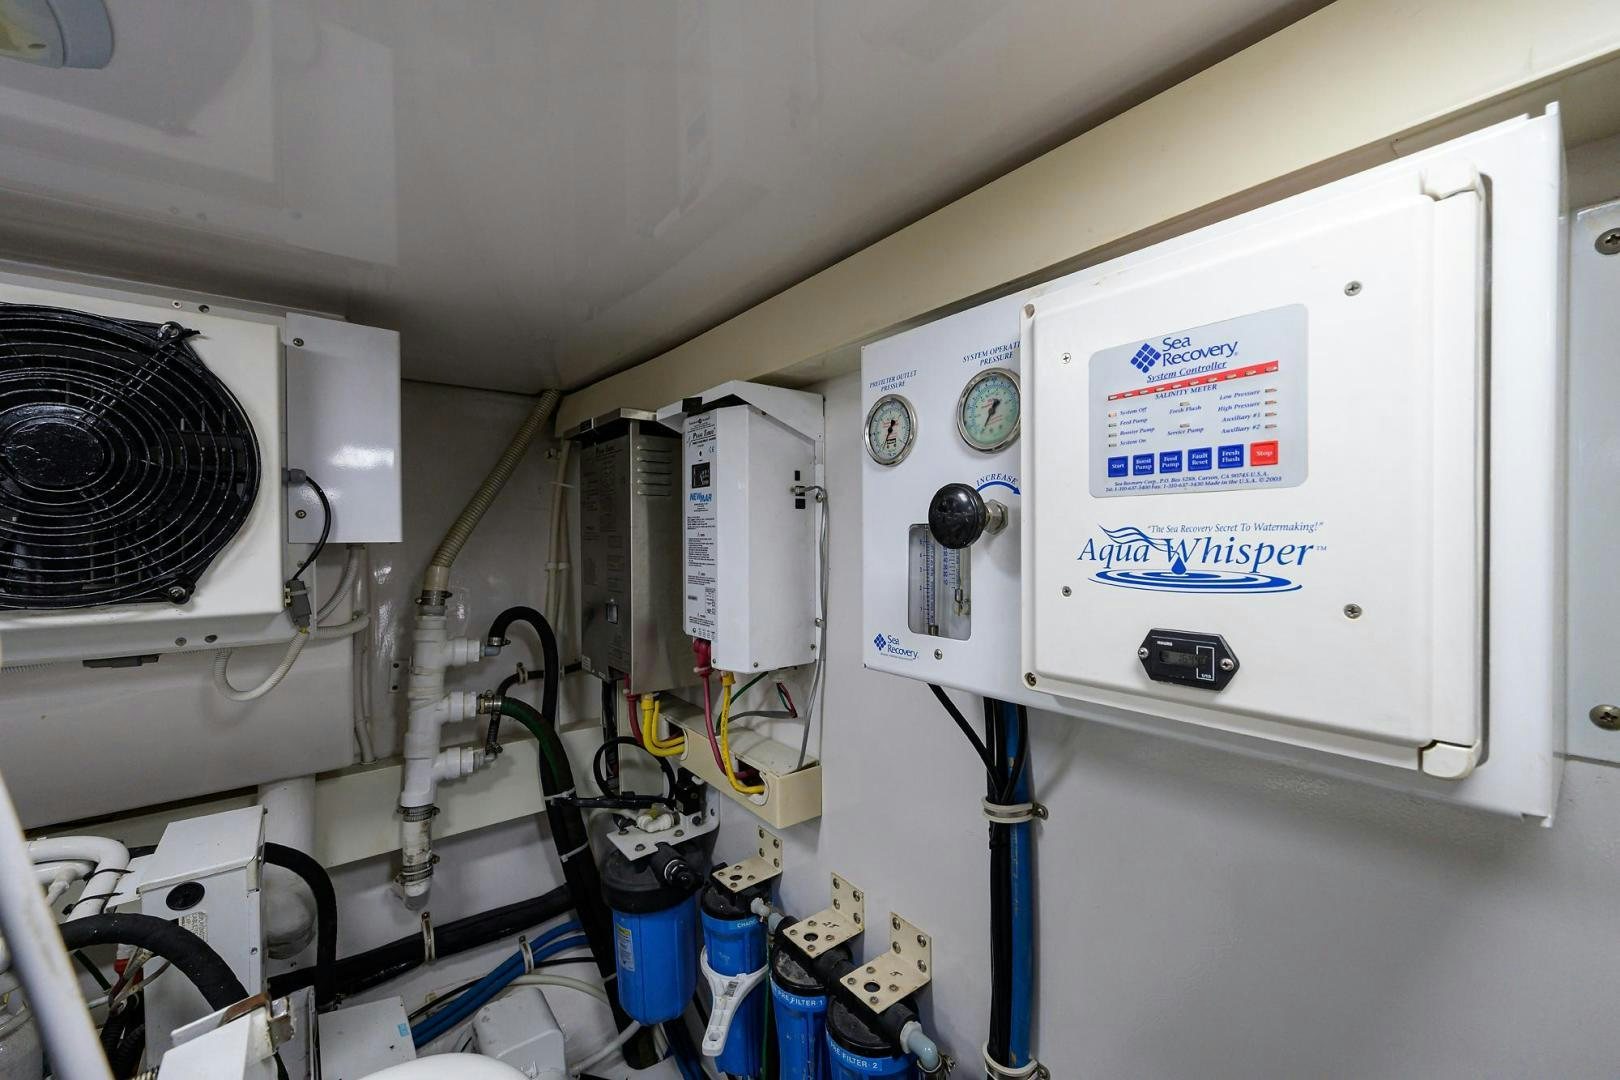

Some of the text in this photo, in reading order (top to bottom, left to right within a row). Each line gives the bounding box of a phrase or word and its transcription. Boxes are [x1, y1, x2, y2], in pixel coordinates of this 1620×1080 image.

[1162, 337, 1191, 352] Sea
[963, 350, 988, 363] SYSTEM
[980, 351, 1014, 366] PRESSURE
[1162, 341, 1238, 366] Recovery
[1147, 361, 1229, 383] System Controller
[869, 369, 917, 389] PREFILTER OUTLET
[881, 381, 905, 392] PRESSURE
[1155, 383, 1218, 400] SALINITY METER
[1234, 390, 1260, 398] Pressure
[1120, 408, 1137, 416] System
[1234, 401, 1260, 410] Pressure
[1222, 414, 1251, 422] Auxiliary
[1222, 426, 1250, 434] Auxiliary
[976, 473, 1018, 486] INCREASE
[689, 492, 713, 503] NEWMAR
[1166, 525, 1179, 534] Sea
[1180, 524, 1213, 535] Recovery
[1215, 522, 1239, 533] Secret
[1240, 522, 1252, 532] To
[1077, 538, 1150, 569] Aqua
[1164, 536, 1314, 573] Whisper
[887, 634, 900, 645] Sea
[887, 644, 919, 660] Recovery
[790, 997, 816, 1007] FILTER
[831, 1041, 841, 1056] PRE
[843, 1052, 868, 1068] FILTER
